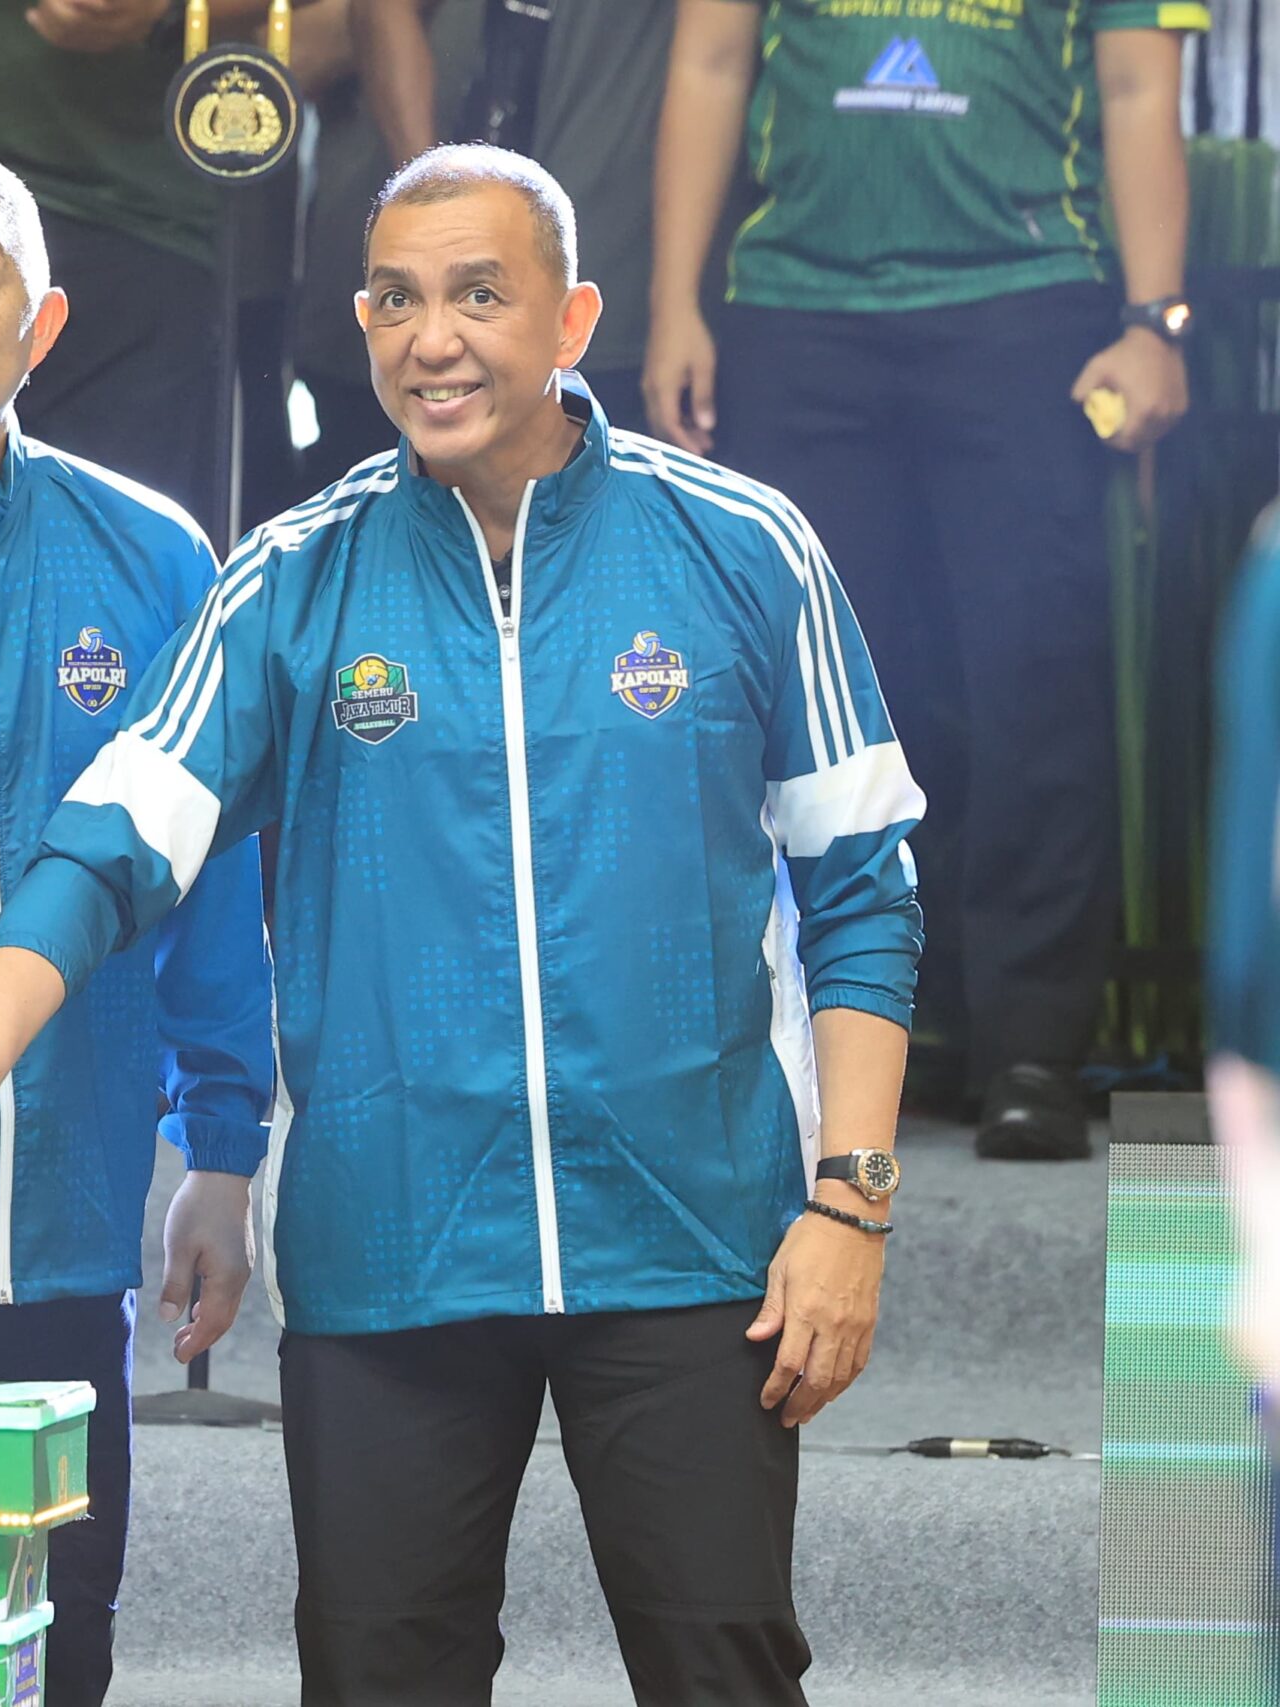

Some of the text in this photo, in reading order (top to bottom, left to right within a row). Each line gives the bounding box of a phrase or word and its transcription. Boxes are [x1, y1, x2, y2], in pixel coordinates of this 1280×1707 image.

[58, 667, 126, 688] KAPOLRI
[611, 669, 689, 692] KAPOLRI
[352, 687, 394, 700] SEMERU
[340, 696, 411, 722] JAWA TIMUR
